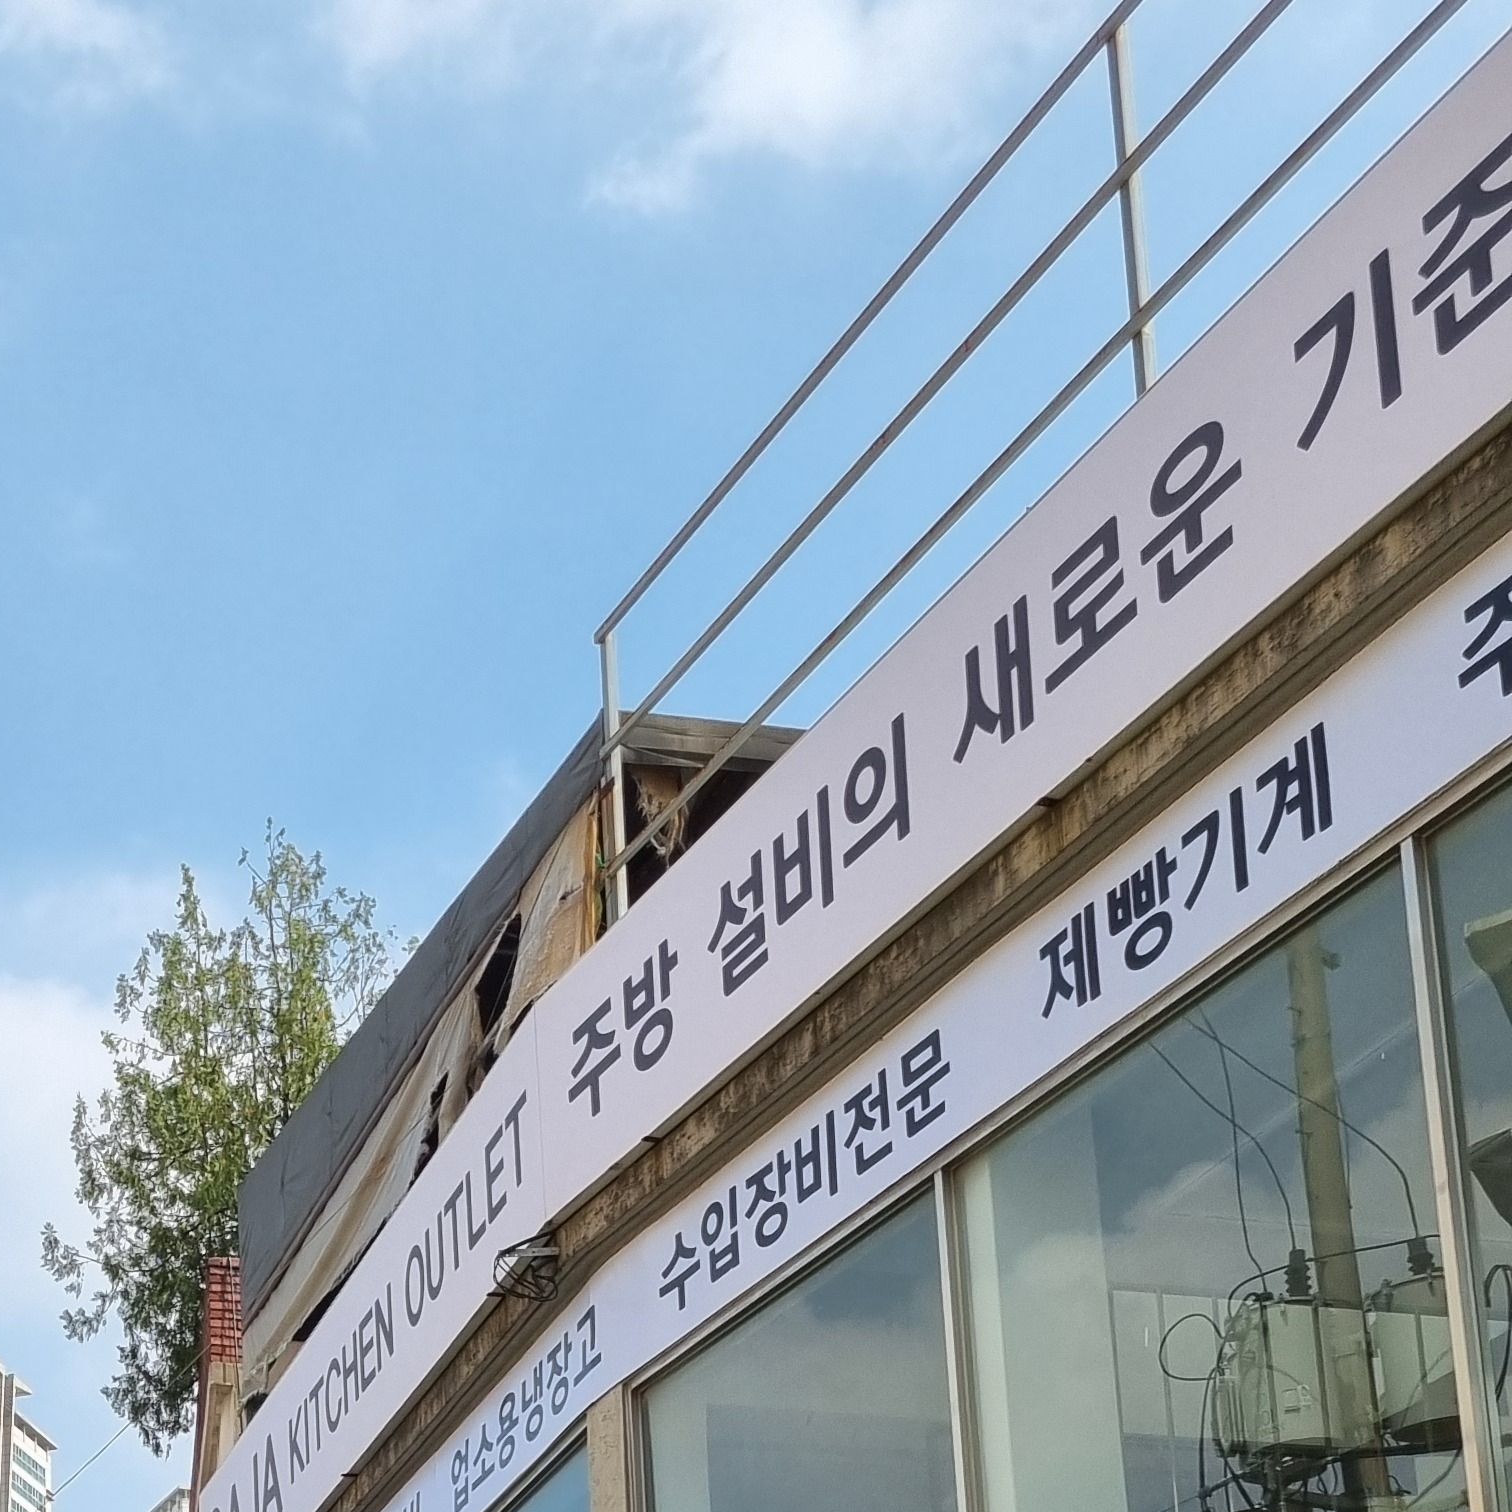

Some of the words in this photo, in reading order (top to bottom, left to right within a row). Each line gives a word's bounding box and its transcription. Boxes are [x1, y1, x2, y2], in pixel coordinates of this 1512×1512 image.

[567, 940, 678, 1115] 주방
[709, 711, 910, 996] 설비의
[953, 419, 1242, 762] 새로운
[659, 1030, 951, 1310] 수입장비전문
[1039, 720, 1334, 1018] 제빵기계
[288, 1283, 395, 1484] KITCHEN
[404, 1090, 528, 1327] OUTLET
